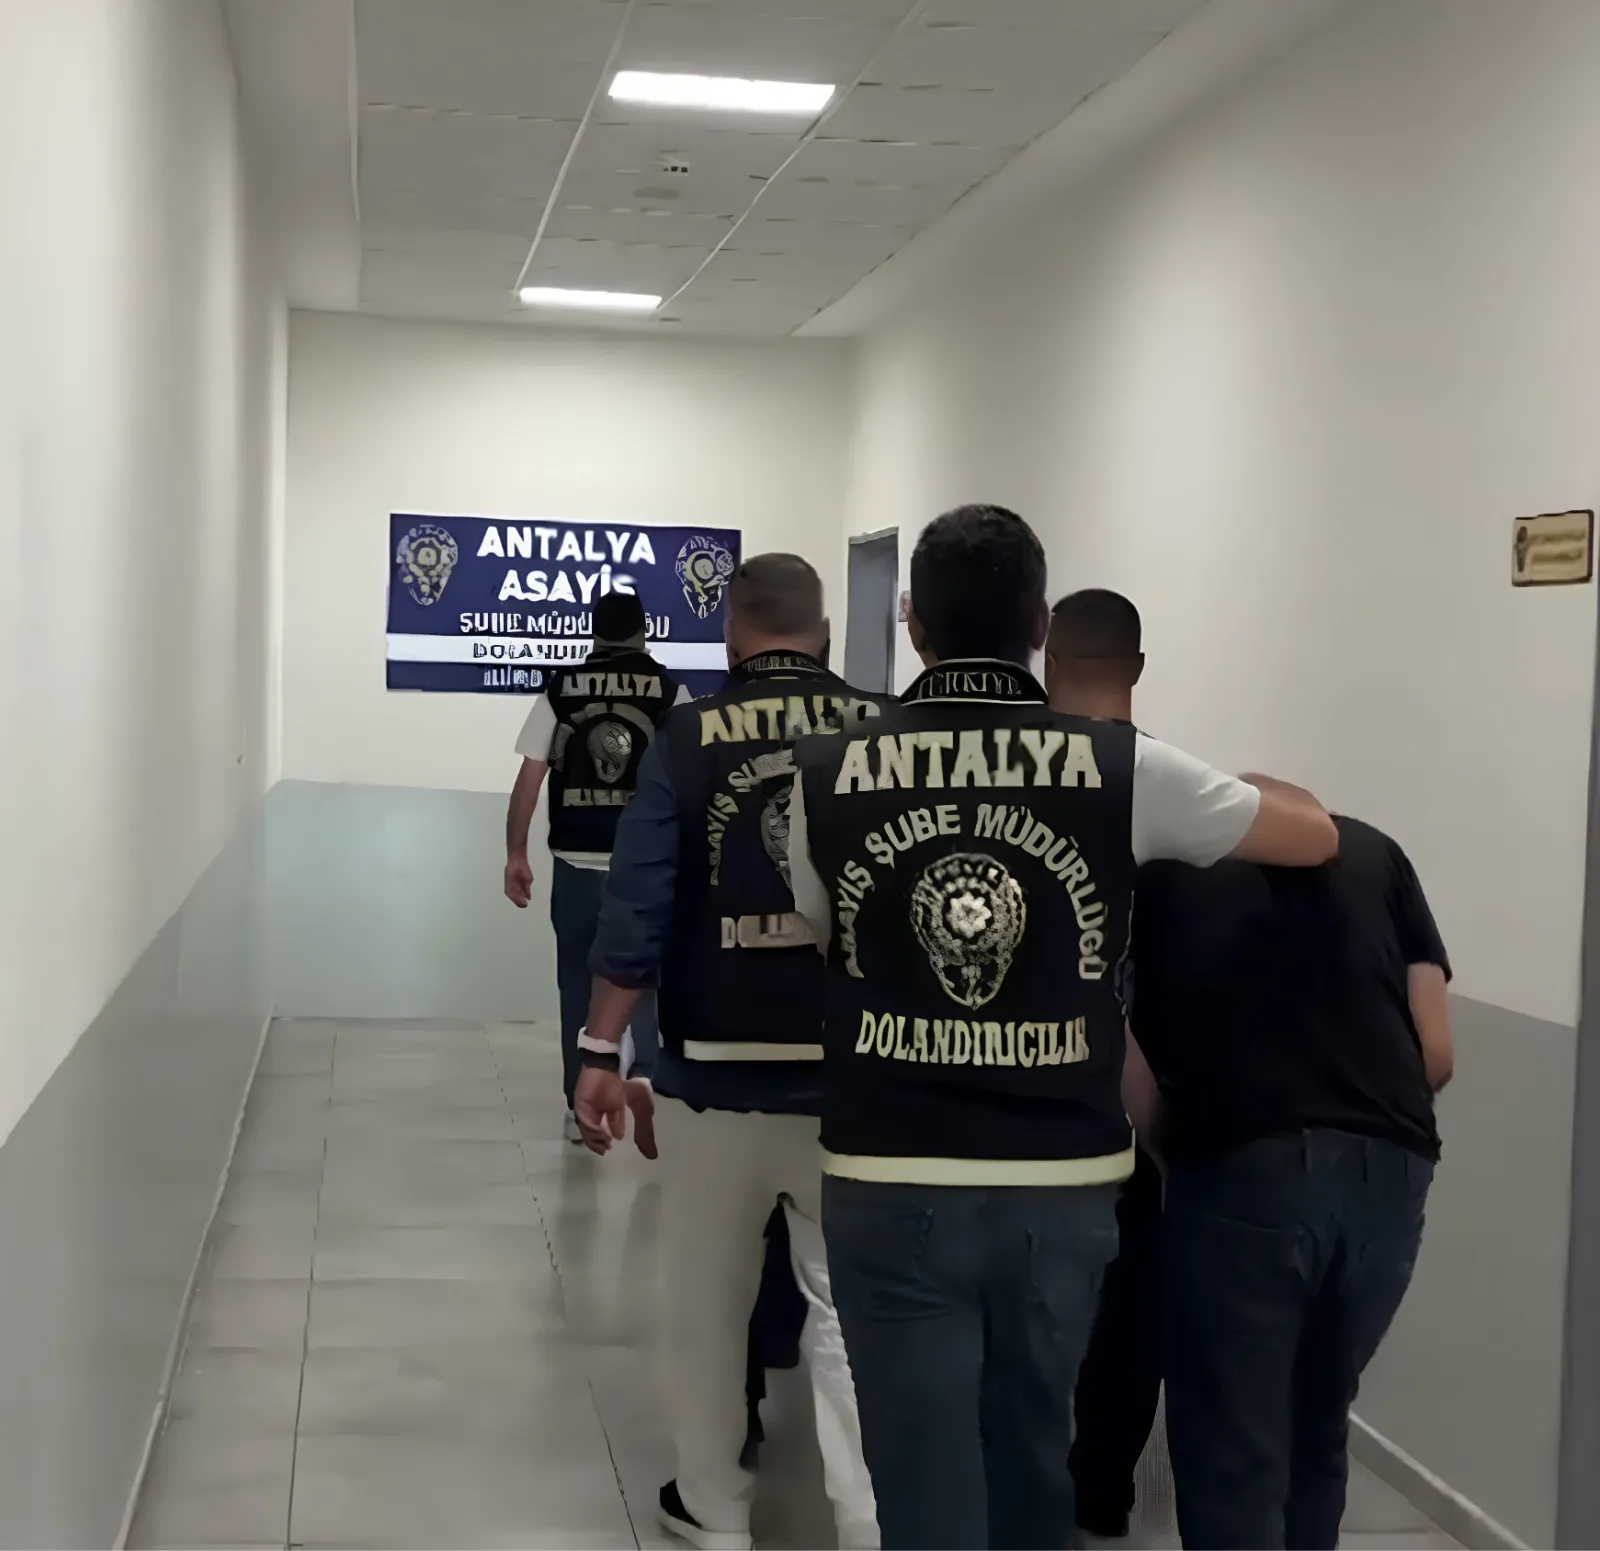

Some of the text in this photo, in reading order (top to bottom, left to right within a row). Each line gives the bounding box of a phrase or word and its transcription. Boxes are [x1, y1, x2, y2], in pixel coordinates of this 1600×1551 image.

[476, 526, 656, 565] ANTALYA
[700, 695, 881, 746] ANTAL
[834, 729, 1102, 794] ANTALYA
[865, 804, 961, 869] ŞUBE
